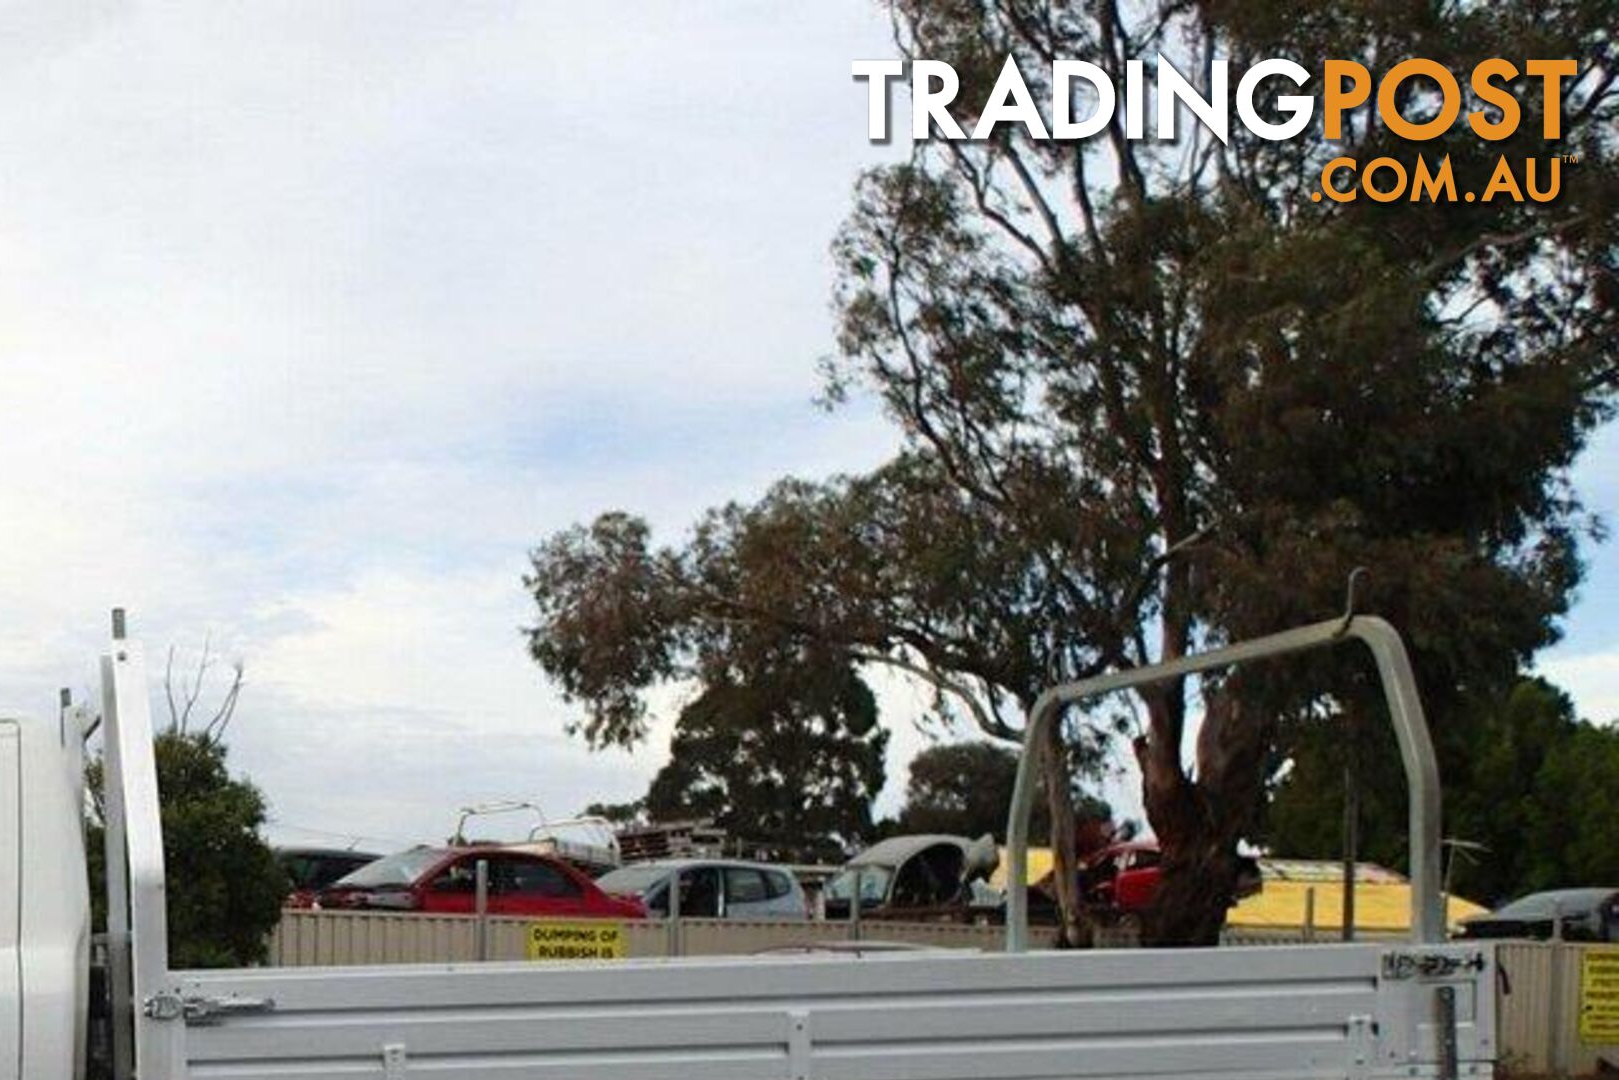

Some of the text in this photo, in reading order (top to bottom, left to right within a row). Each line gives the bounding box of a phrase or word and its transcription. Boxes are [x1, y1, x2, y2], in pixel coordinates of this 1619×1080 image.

[534, 929, 617, 942] DUMPING OF
[539, 946, 613, 958] RUBBISH IS
